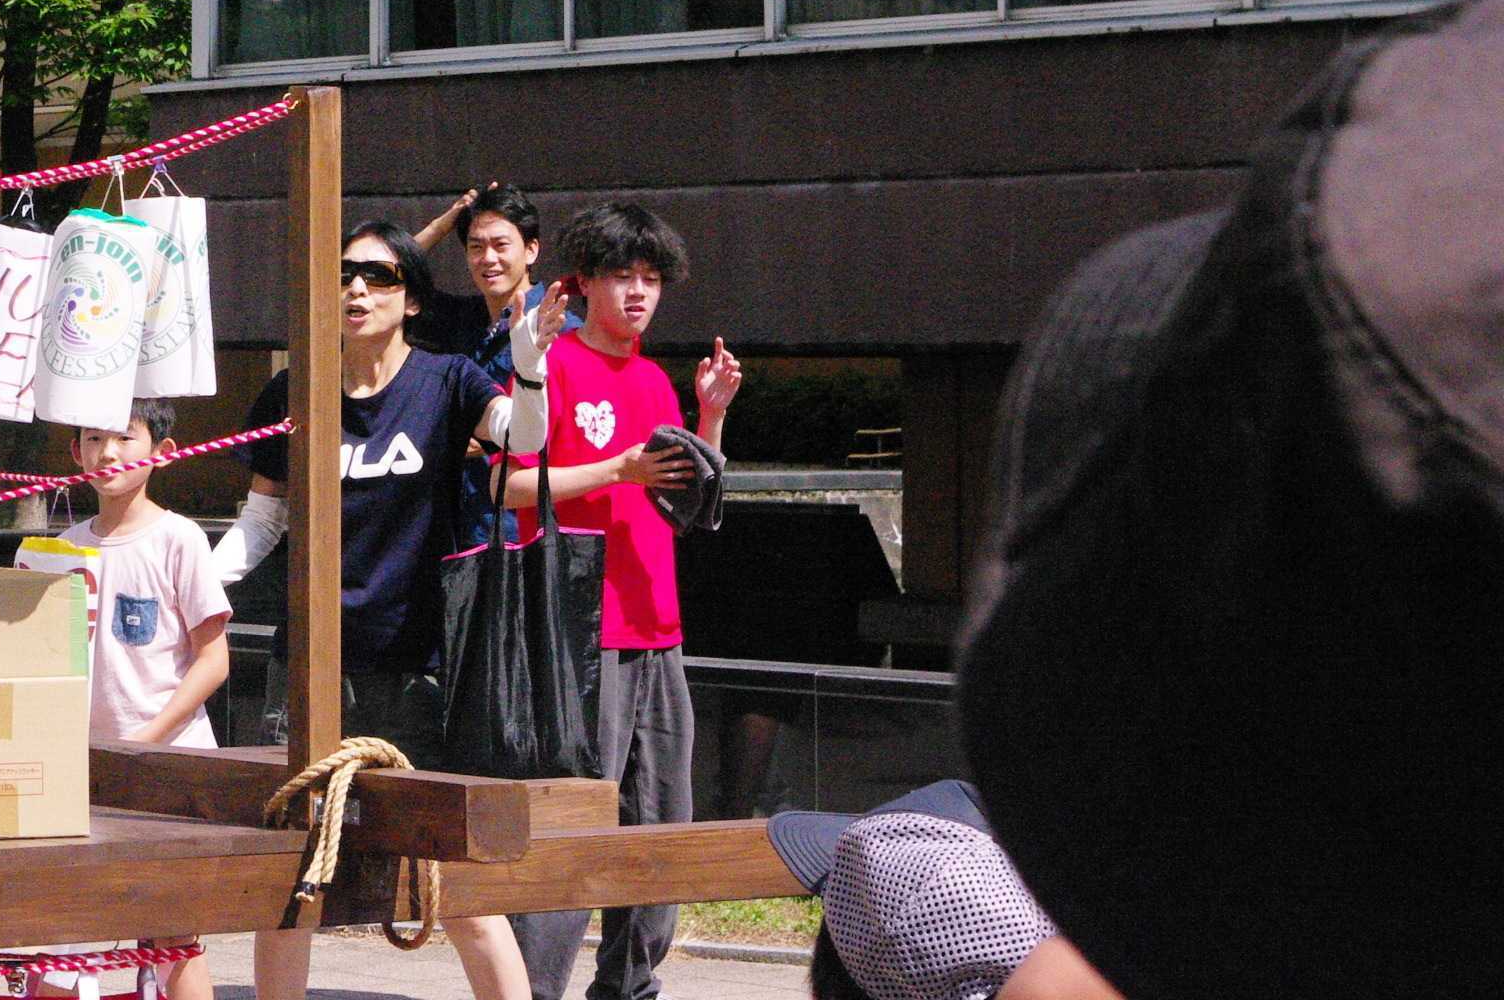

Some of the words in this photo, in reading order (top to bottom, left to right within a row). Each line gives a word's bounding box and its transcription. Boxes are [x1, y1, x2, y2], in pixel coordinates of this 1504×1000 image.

[59, 231, 144, 284] en-join
[51, 348, 87, 378] FES
[339, 431, 424, 480] ILA
